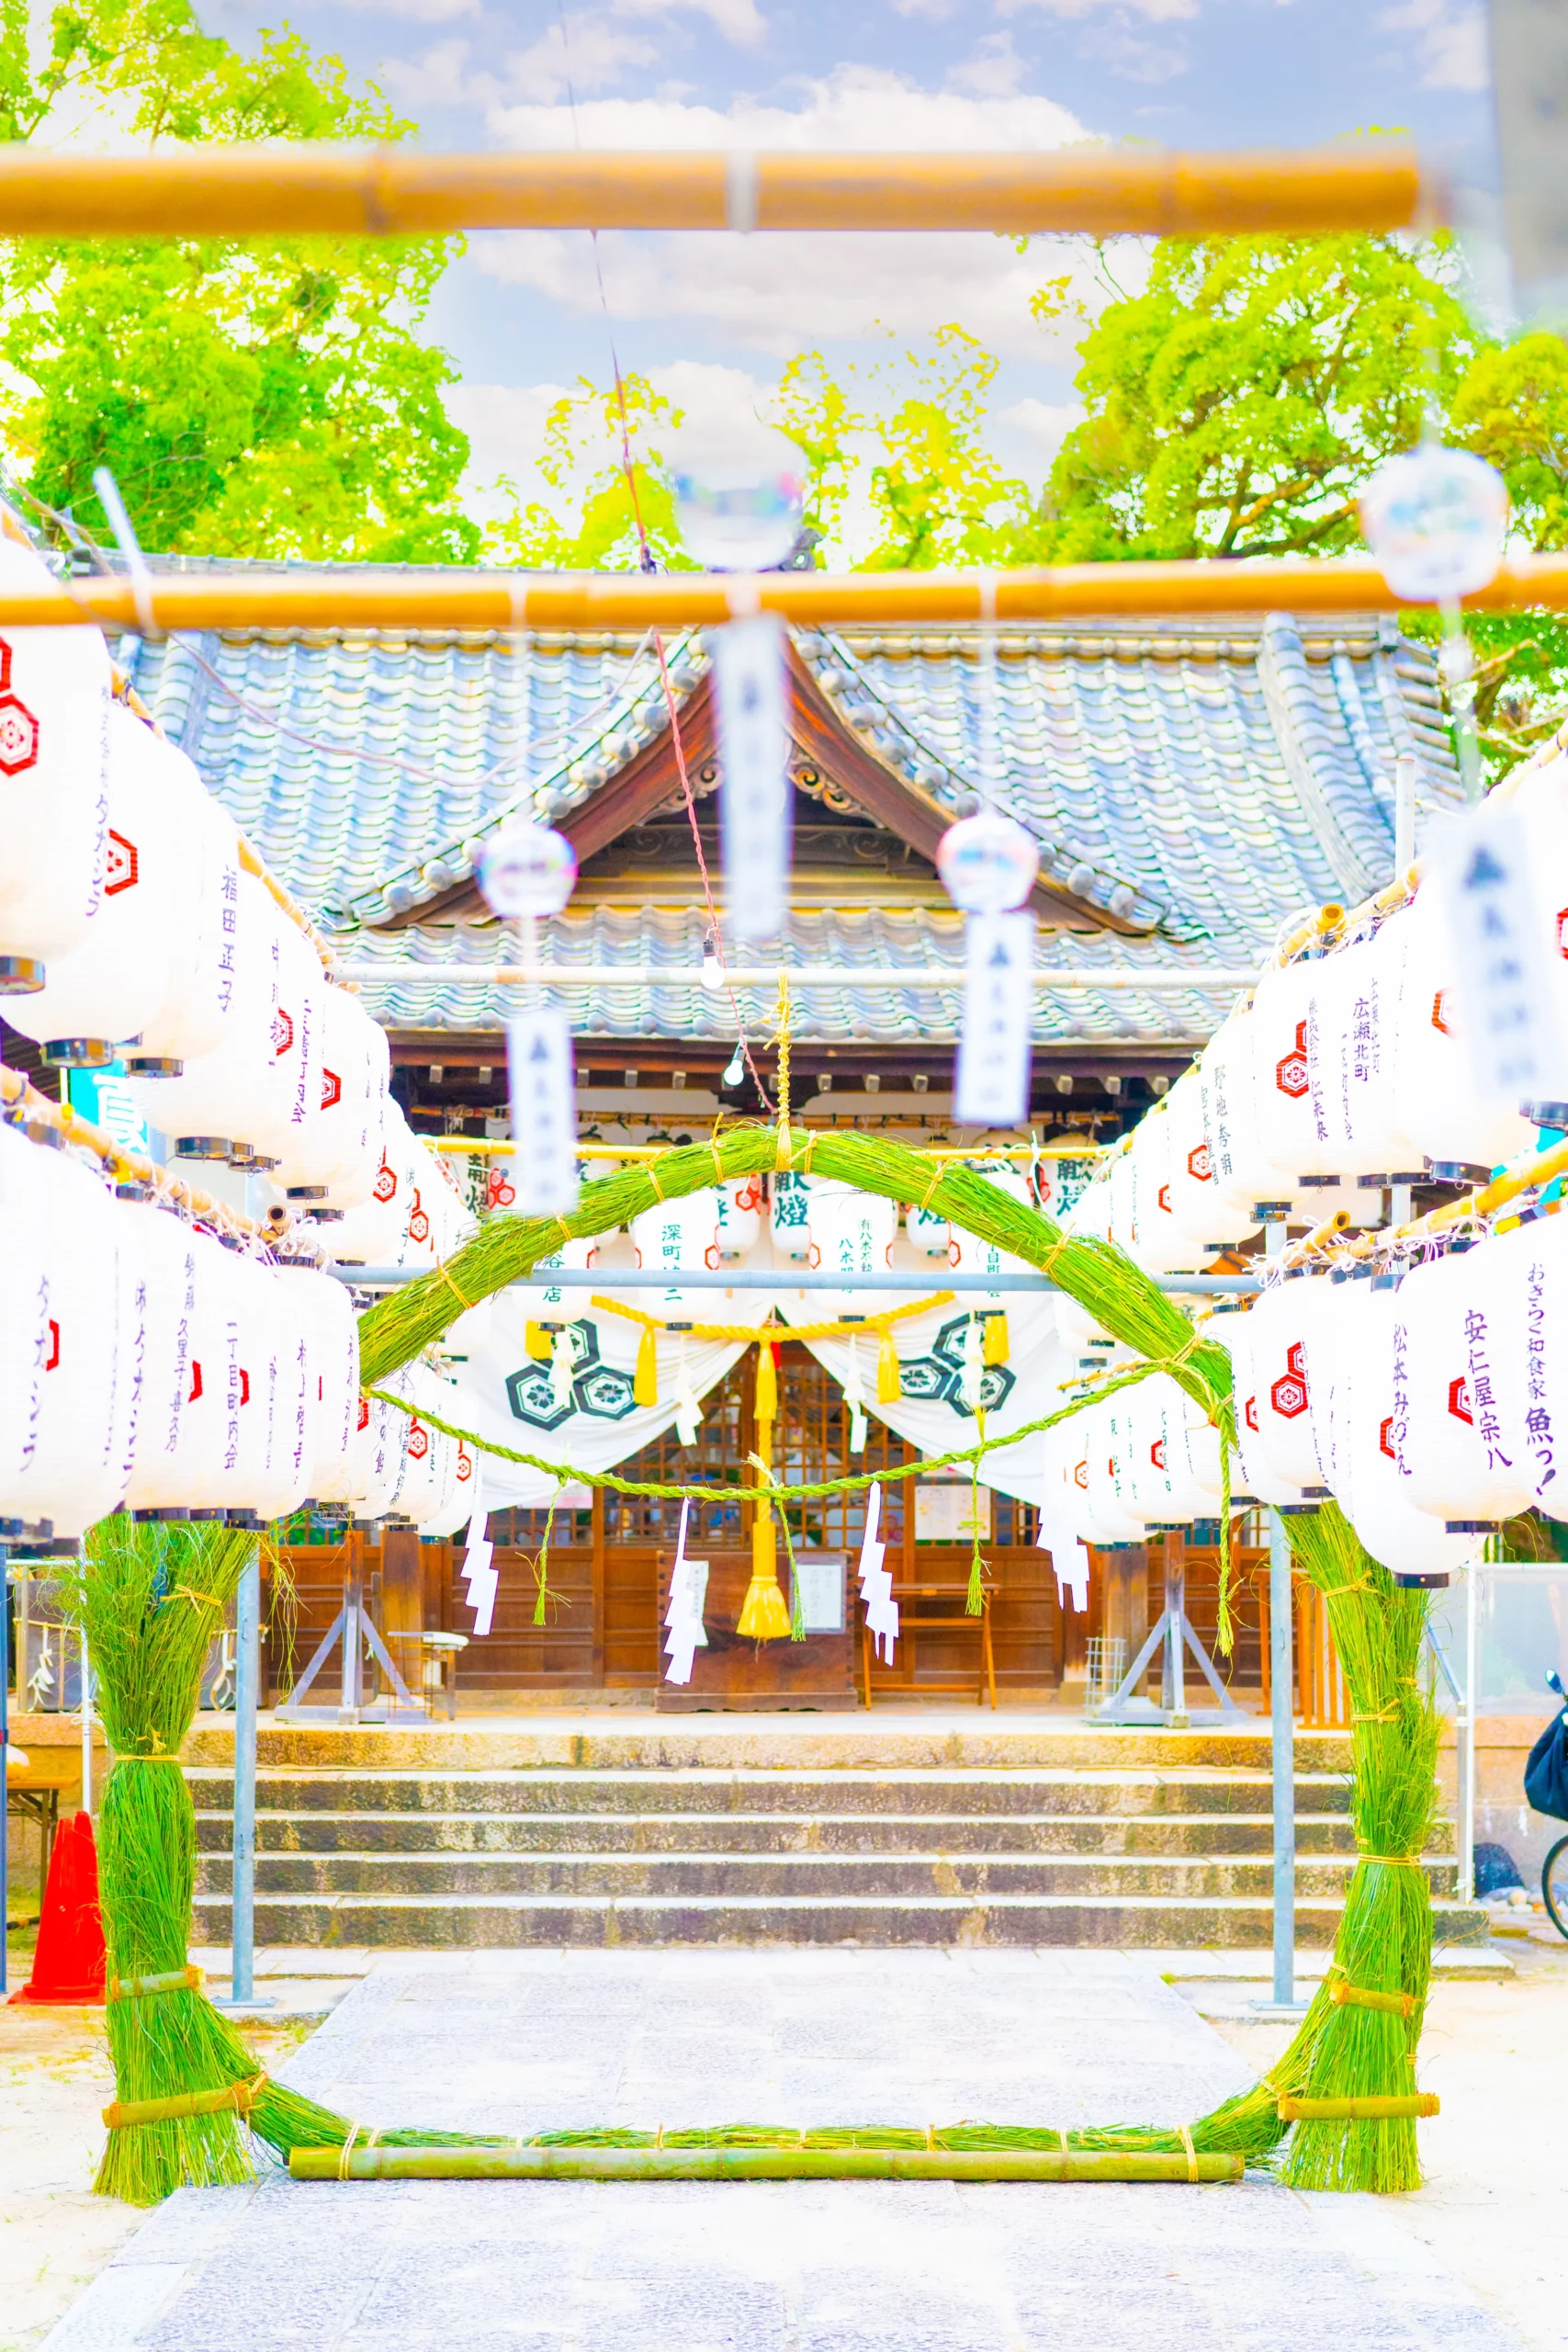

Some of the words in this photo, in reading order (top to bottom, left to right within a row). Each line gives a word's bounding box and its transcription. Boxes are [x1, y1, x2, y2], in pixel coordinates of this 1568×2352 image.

[1353, 998, 1371, 1081] 広瀬北町
[661, 1224, 683, 1301] 深町二
[1393, 1324, 1412, 1476] 松本みづえ
[1463, 1309, 1513, 1470] 安仁屋宗八
